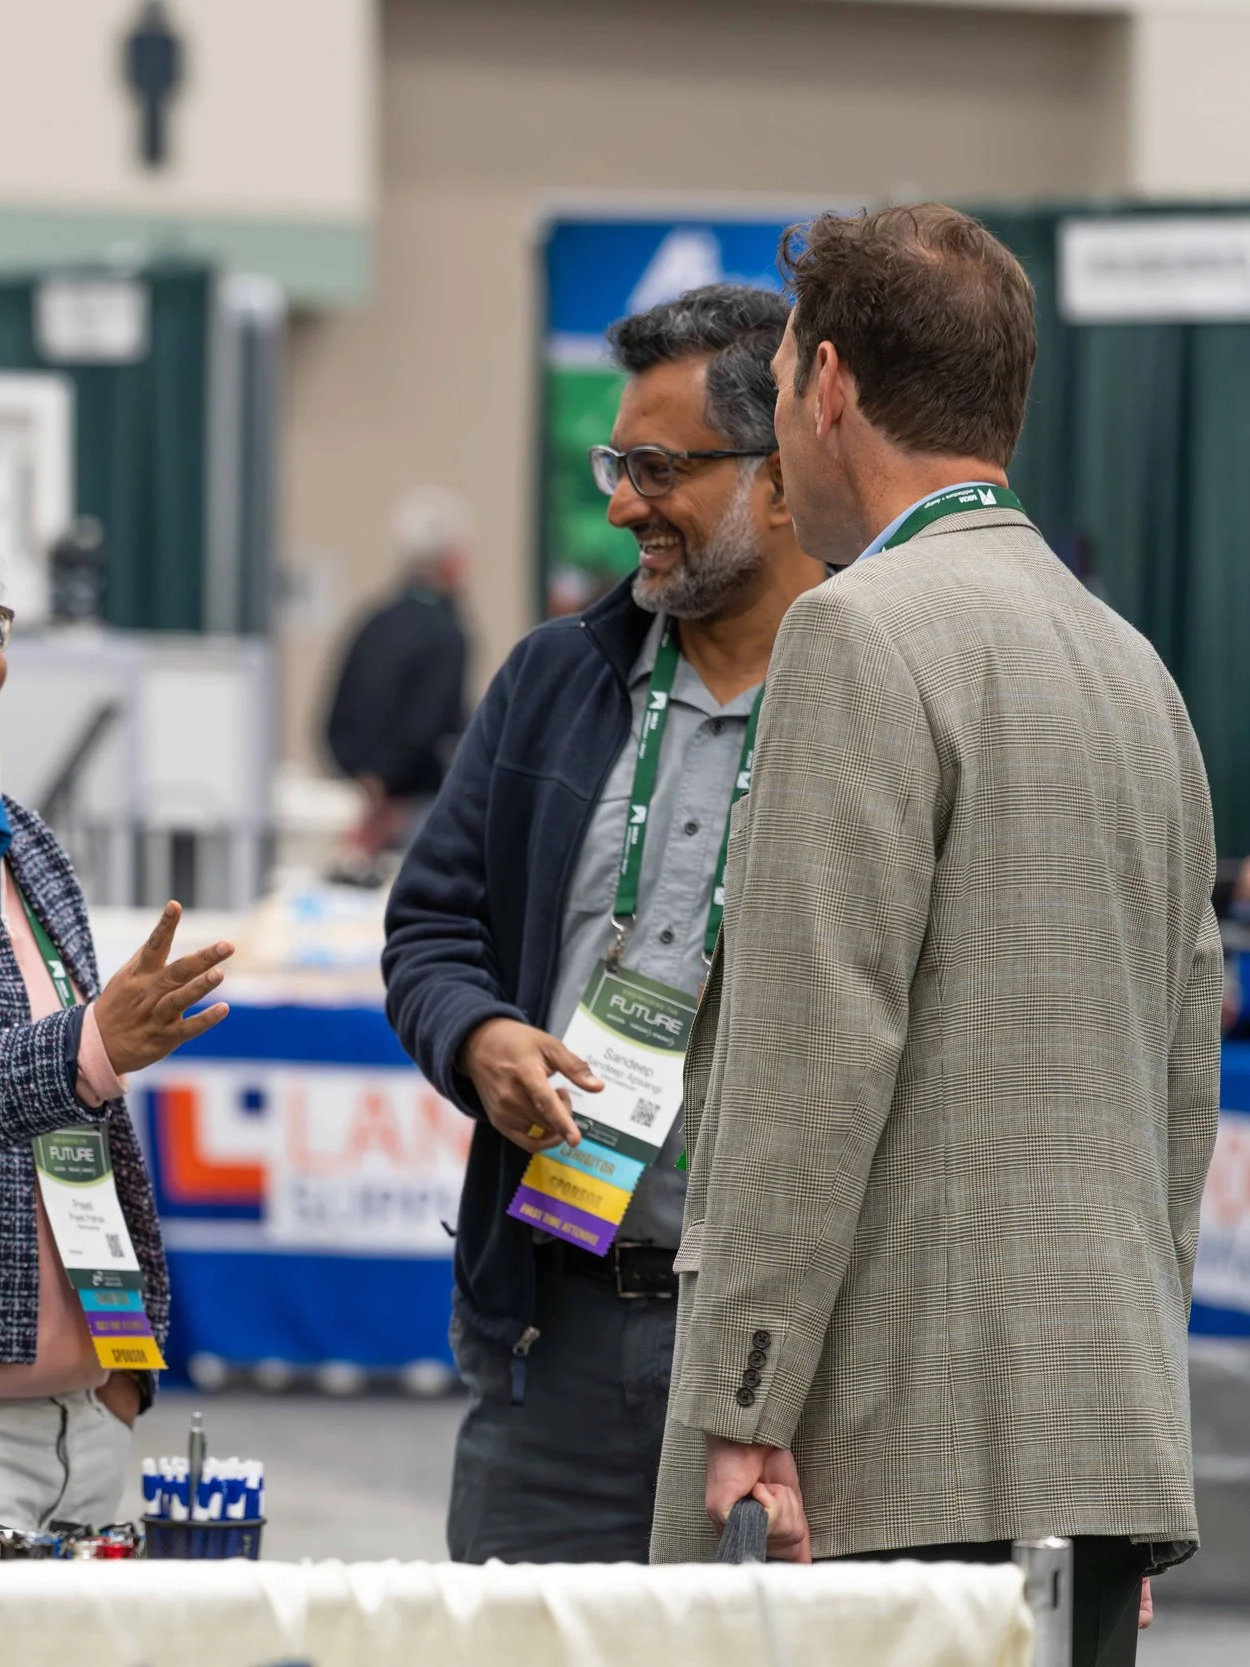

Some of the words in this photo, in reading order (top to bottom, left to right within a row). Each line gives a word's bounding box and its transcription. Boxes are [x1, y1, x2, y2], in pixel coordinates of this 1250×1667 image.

[609, 993, 685, 1036] FUTURE
[602, 1046, 655, 1078] Sandeep
[49, 1144, 95, 1163] FUTURE
[549, 1175, 604, 1209] SPONSOR
